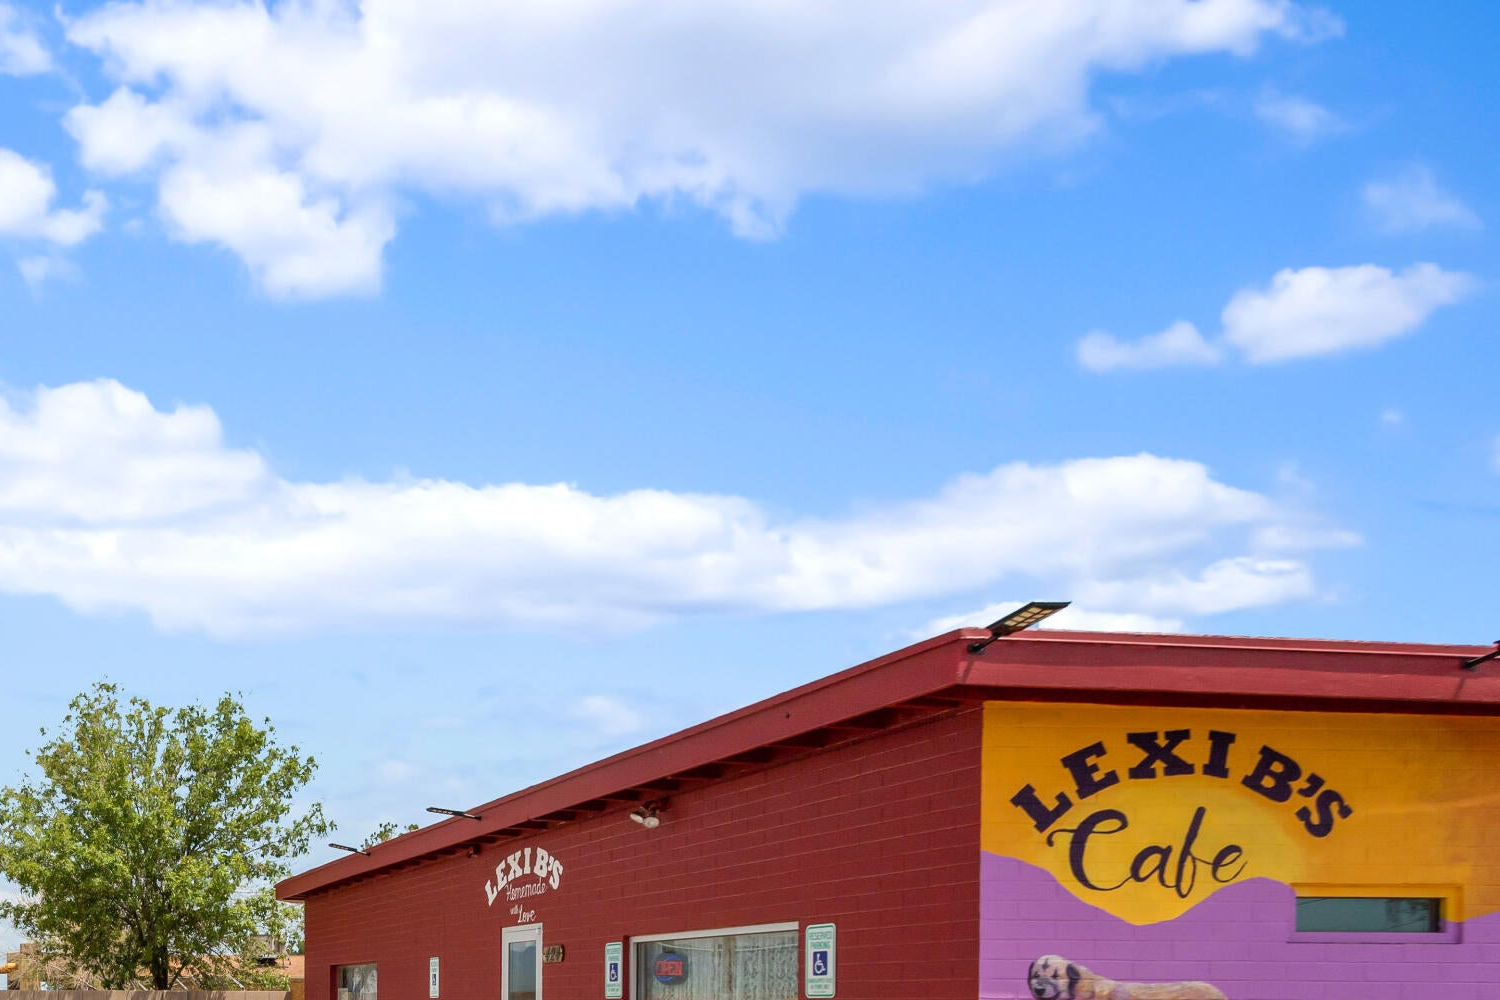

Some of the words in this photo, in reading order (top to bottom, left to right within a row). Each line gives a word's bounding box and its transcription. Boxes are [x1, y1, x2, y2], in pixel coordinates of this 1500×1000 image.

[1046, 806, 1248, 898] Cafe
[505, 877, 547, 902] Homemade
[517, 903, 537, 923] Love
